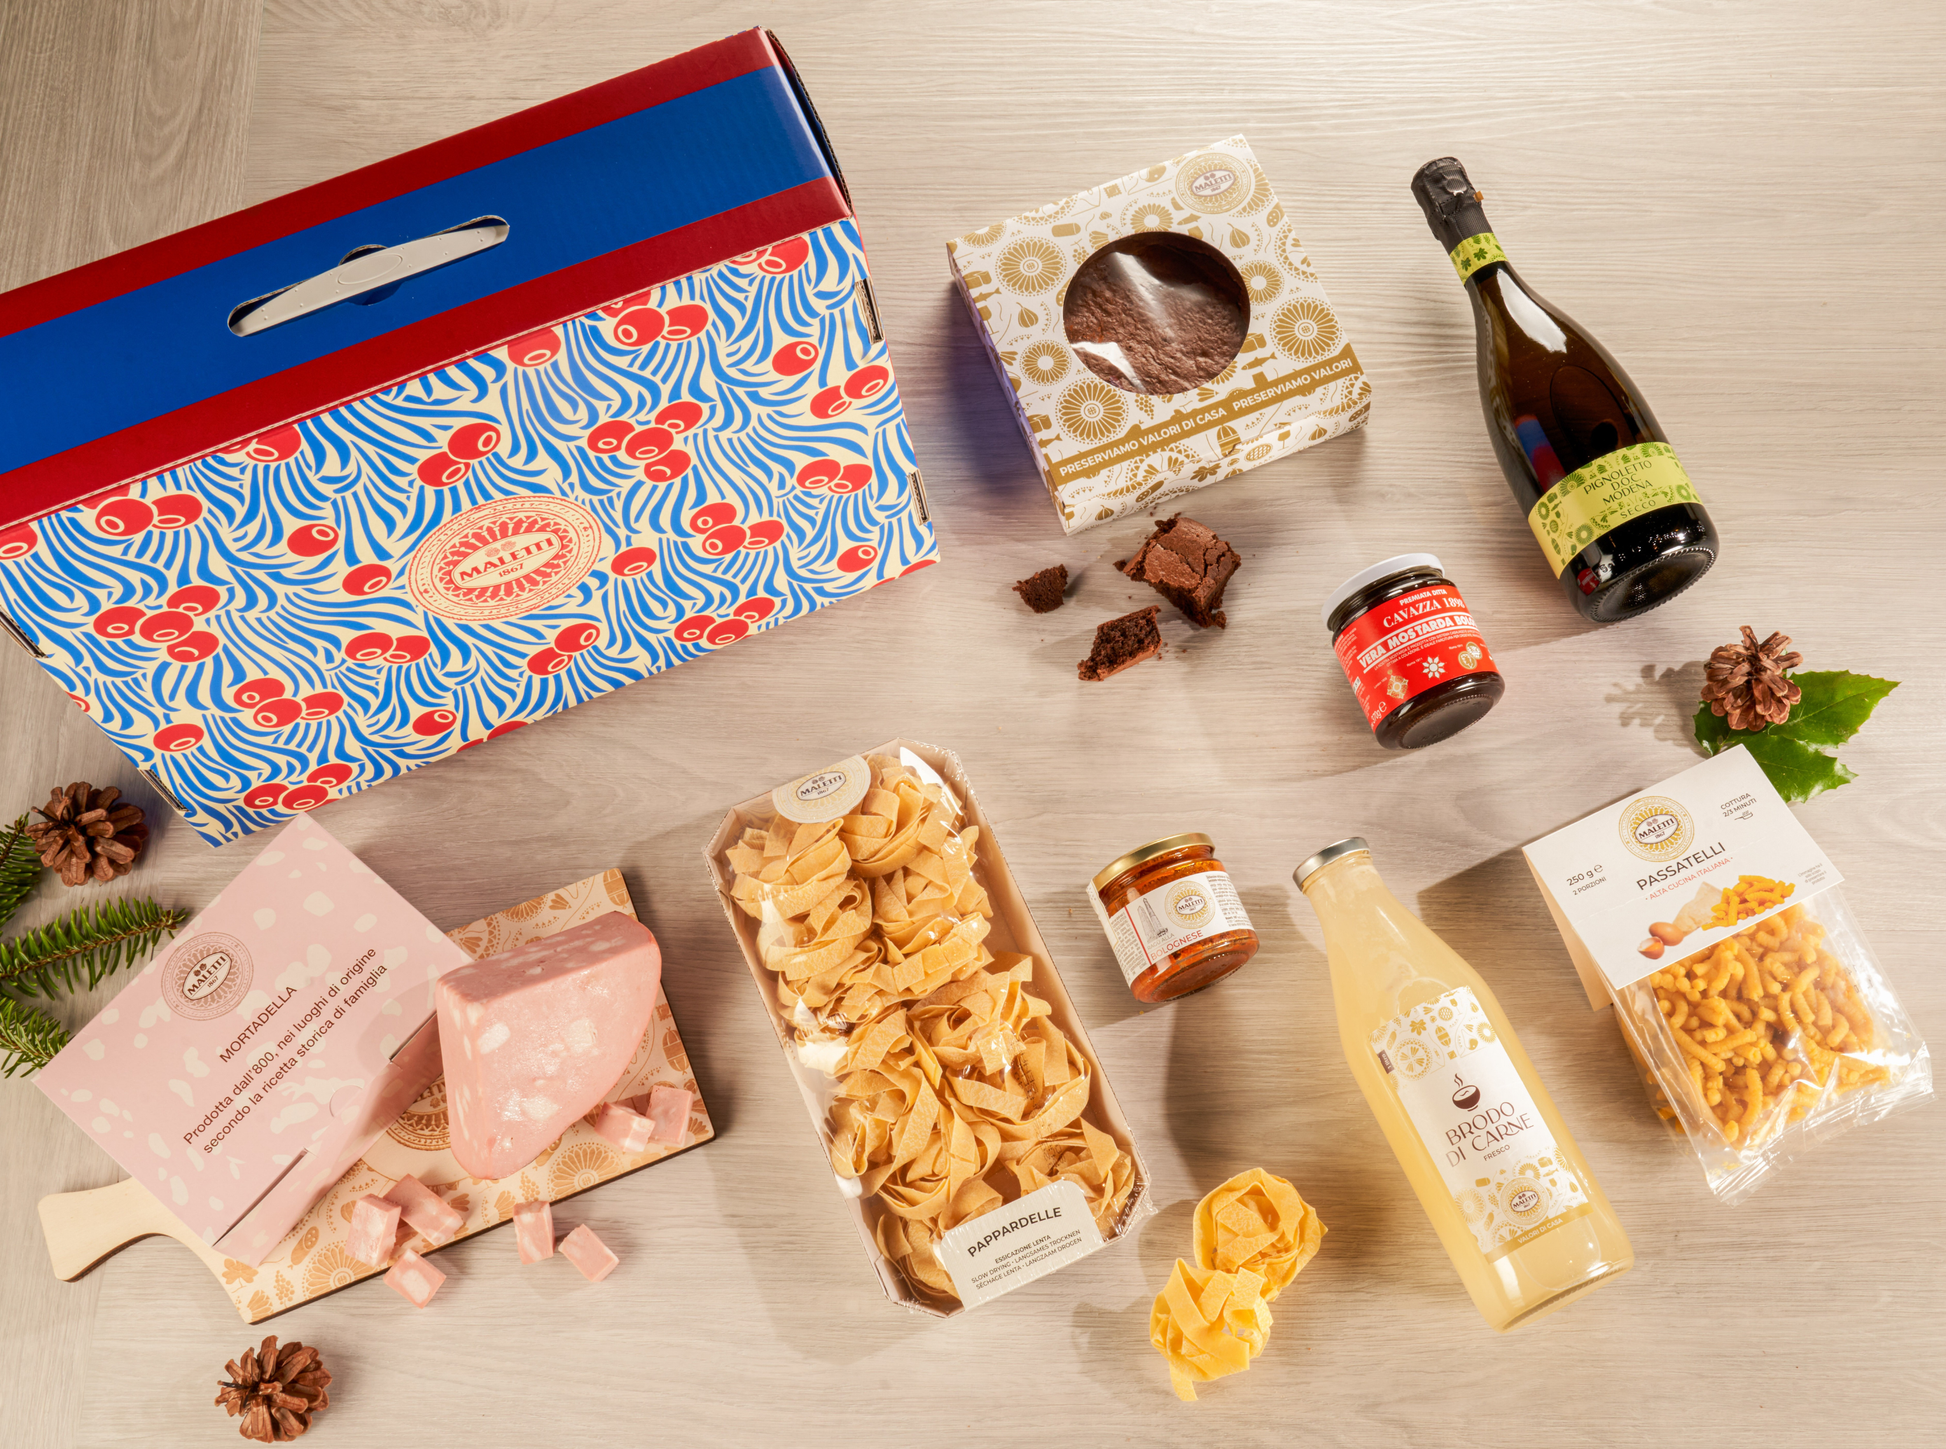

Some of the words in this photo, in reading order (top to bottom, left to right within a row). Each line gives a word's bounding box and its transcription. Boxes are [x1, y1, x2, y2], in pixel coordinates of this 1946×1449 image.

[1195, 173, 1232, 192] MALETTI
[1059, 439, 1139, 476] PRESERVIAMO
[1138, 423, 1181, 446] VALORI
[1182, 418, 1195, 431] DI
[1196, 407, 1228, 426] CASA
[1232, 375, 1311, 411] PRESERVIAMO
[1311, 357, 1353, 381] VALORI
[1583, 460, 1652, 495] PIGNOLETTO
[1602, 480, 1653, 505] MODENA
[1620, 499, 1656, 519] SECCO
[458, 537, 555, 582] MALETTI
[498, 563, 524, 578] 1867
[1399, 591, 1433, 606] PREMIATA
[1432, 588, 1448, 597] DITTA
[1383, 601, 1441, 628] CAVAZZA
[1358, 645, 1387, 668] VERA
[1387, 616, 1454, 650] MOSTARDA
[800, 774, 842, 796] MALETTI
[1720, 792, 1751, 810] COTTURA
[1722, 808, 1733, 818] 2/3
[1733, 798, 1757, 815] MINUTI
[1638, 818, 1676, 840] MALETTI
[1566, 871, 1586, 887] 250
[1586, 870, 1594, 880] g
[1636, 841, 1726, 891] PASSATELLI
[1648, 888, 1667, 901] ALTA
[1667, 873, 1696, 893] CUCINA
[1695, 856, 1731, 878] ITALIANA
[1577, 876, 1607, 893] PORZIONI
[1178, 898, 1204, 911] MALETTI
[1151, 930, 1204, 961] BOLOGNESE
[187, 956, 227, 996] MALETTI
[219, 986, 297, 1063] MORTADELLA
[183, 1094, 234, 1145] Prodotta
[232, 1051, 279, 1096] dall'800,
[276, 1029, 296, 1050] nei
[293, 996, 329, 1032] luoghi
[328, 984, 341, 999] di
[340, 948, 377, 986] origine
[203, 1104, 251, 1154] secondo
[248, 1092, 264, 1106] la
[262, 1056, 298, 1094] ricetta
[297, 1021, 335, 1057] storica
[333, 1005, 346, 1020] di
[343, 965, 388, 1008] famiglia
[1445, 1101, 1515, 1146] BRODO
[1445, 1145, 1467, 1168] DI
[1471, 1112, 1534, 1152] CARNE
[1483, 1144, 1511, 1161] FRESCO
[1512, 1193, 1537, 1209] MALETTI
[967, 1206, 1062, 1258] PAPPARDELLE
[1032, 1234, 1051, 1248] LENTA
[1517, 1228, 1540, 1245] VALORI
[1539, 1224, 1547, 1233] DI
[1546, 1217, 1564, 1231] CASA
[971, 1272, 989, 1284] SLOW
[989, 1261, 1011, 1276] DRYING
[1014, 1244, 1050, 1265] LANGSAMES
[1049, 1229, 1081, 1247] TROCKNEN
[975, 1273, 1003, 1290] SÉCHAGE
[1003, 1265, 1022, 1279] LENTA
[1024, 1249, 1058, 1267] LANGZAAM
[1057, 1236, 1083, 1252] DROGEN
